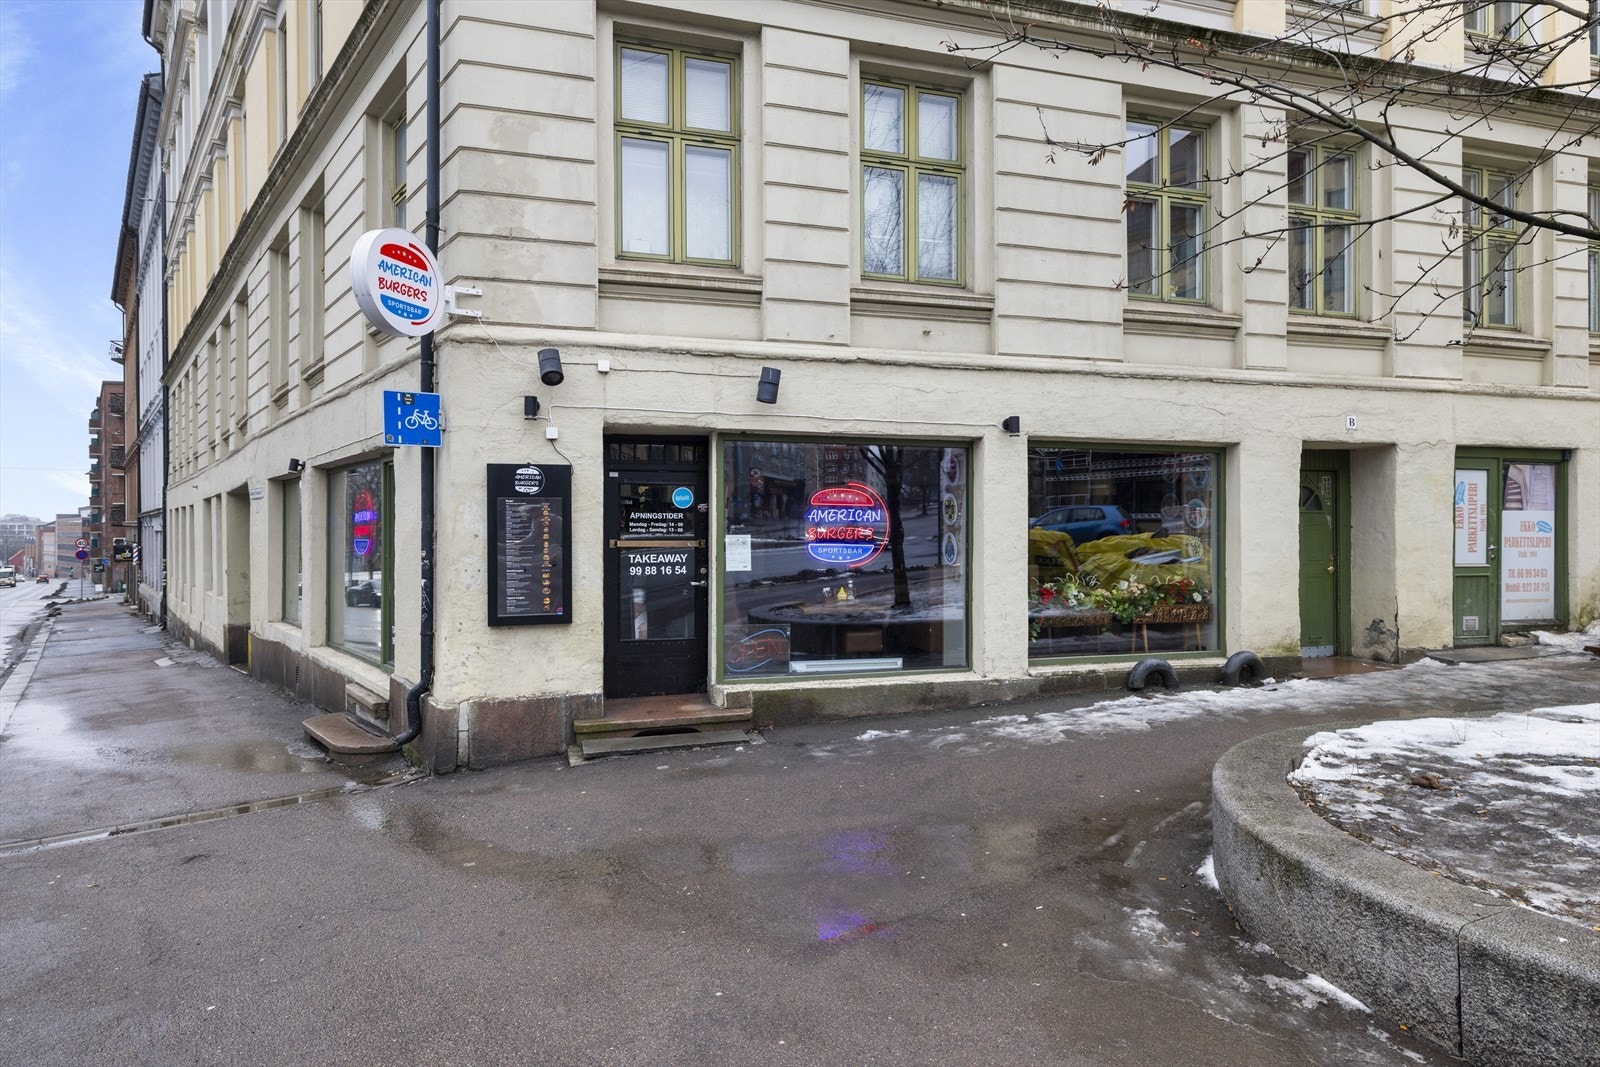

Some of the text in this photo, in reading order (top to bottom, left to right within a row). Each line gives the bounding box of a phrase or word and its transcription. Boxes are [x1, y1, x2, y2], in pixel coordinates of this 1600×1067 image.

[378, 260, 432, 287] AMERICAN
[378, 278, 428, 302] BURGERS
[388, 300, 422, 315] SPORTSBAR
[1350, 418, 1355, 426] B
[808, 508, 881, 523] AMERICAN
[1456, 506, 1464, 529] EKKO
[1468, 484, 1477, 553] PARKETTSLIPERI
[808, 526, 874, 541] BURGERS
[1520, 520, 1536, 532] EKKO
[1504, 536, 1552, 548] PARKETTSLIPERI
[628, 554, 688, 564] TAKEAWAY
[630, 566, 687, 575] 99 88 16 54
[1504, 582, 1521, 592] Mobil:
[728, 638, 784, 664] OPEN
